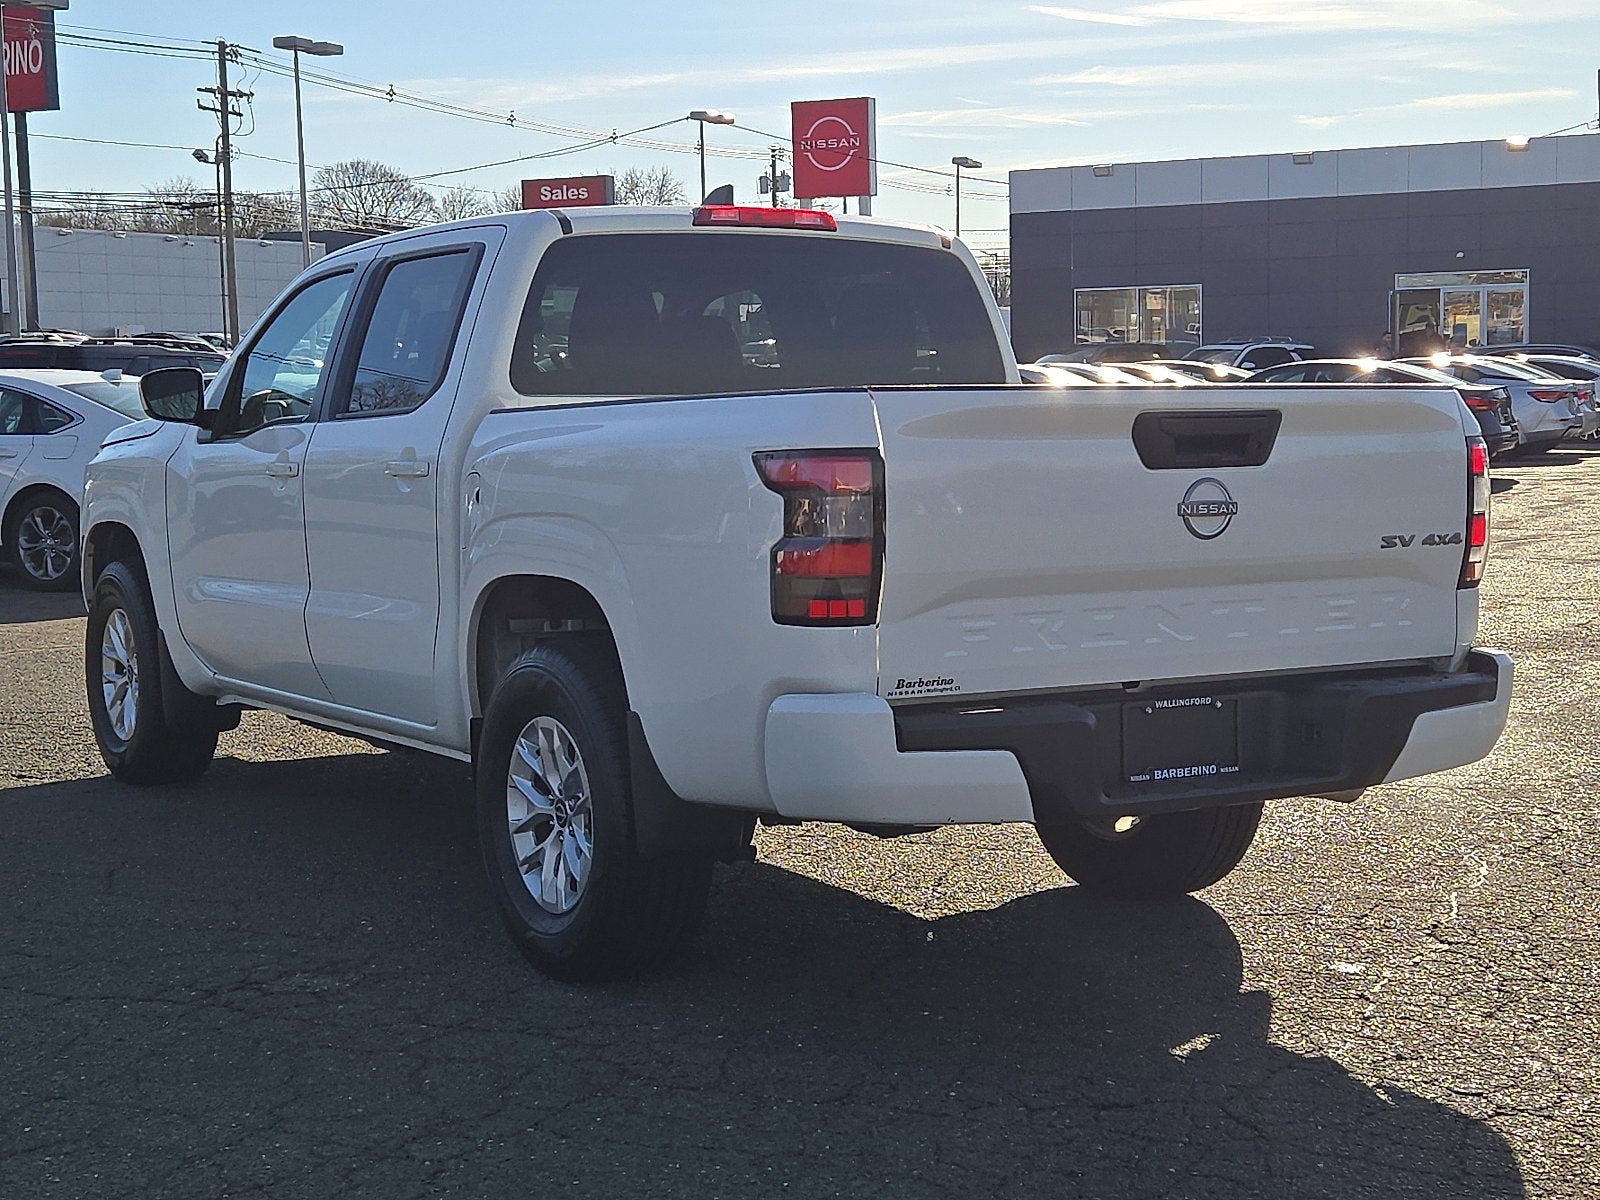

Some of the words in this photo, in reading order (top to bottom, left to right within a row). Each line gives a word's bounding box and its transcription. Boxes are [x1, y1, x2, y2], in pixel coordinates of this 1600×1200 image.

[800, 136, 861, 150] NISSAN
[540, 185, 589, 202] Sales
[1180, 503, 1237, 515] NISSAN
[1380, 534, 1416, 549] SV
[895, 676, 954, 689] Barberino
[1154, 697, 1212, 708] WALLINGFORD
[1130, 774, 1150, 782] NISSAN
[1154, 765, 1217, 779] BARBERINO
[1220, 766, 1239, 774] NISSAN
